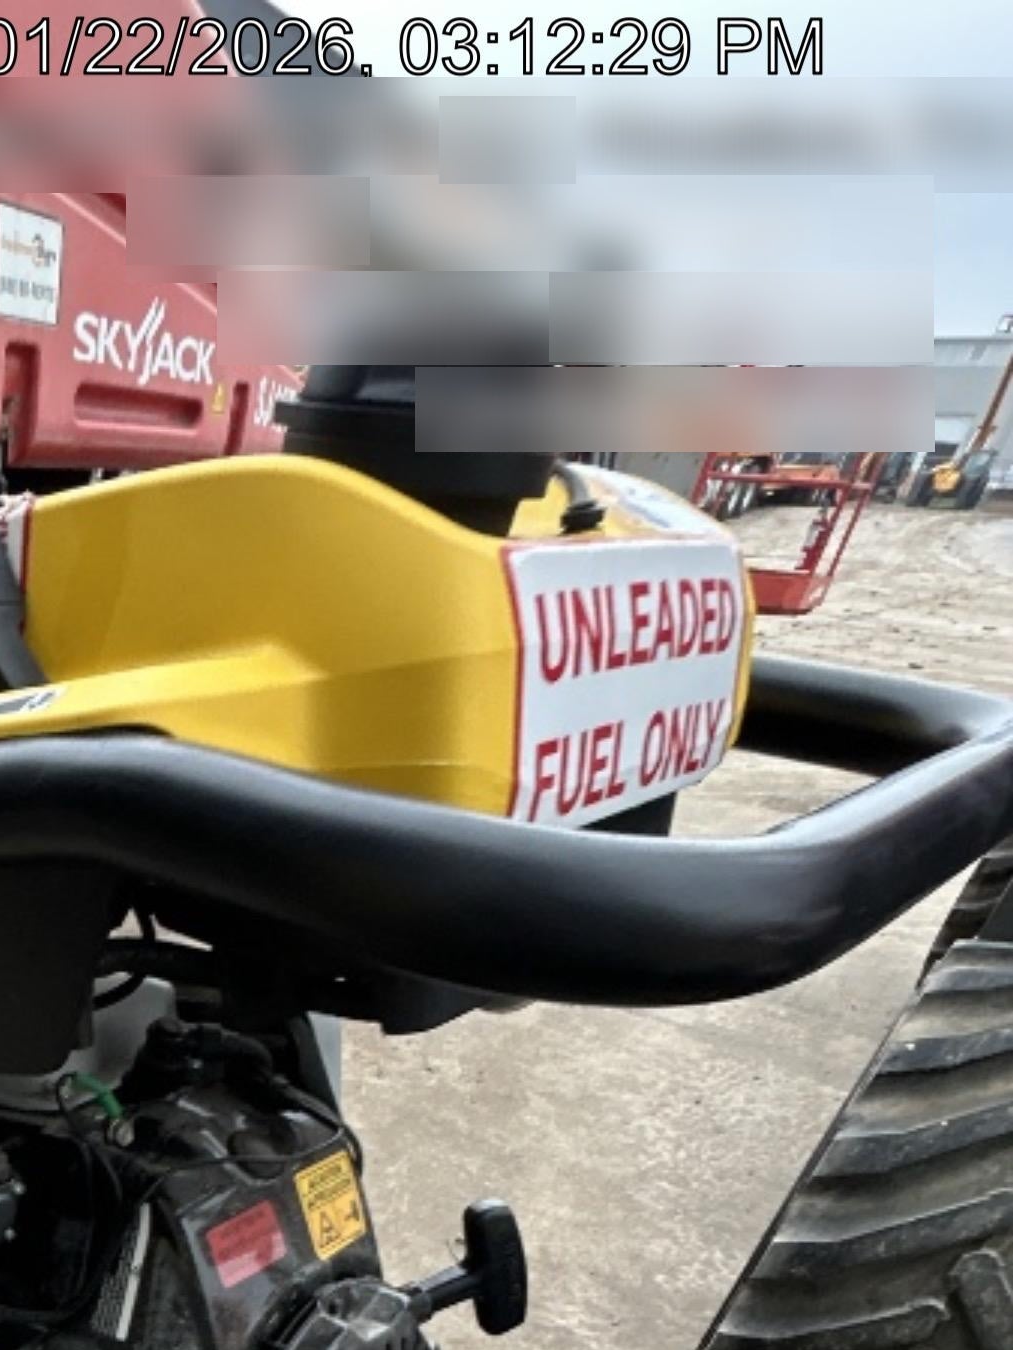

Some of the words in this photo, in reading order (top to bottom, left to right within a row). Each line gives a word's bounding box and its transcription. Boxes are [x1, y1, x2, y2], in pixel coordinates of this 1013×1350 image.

[73, 296, 216, 387] SKYJACK
[535, 578, 736, 684] UNLEADED
[527, 720, 626, 822] FUEL
[640, 698, 726, 788] ONLY
